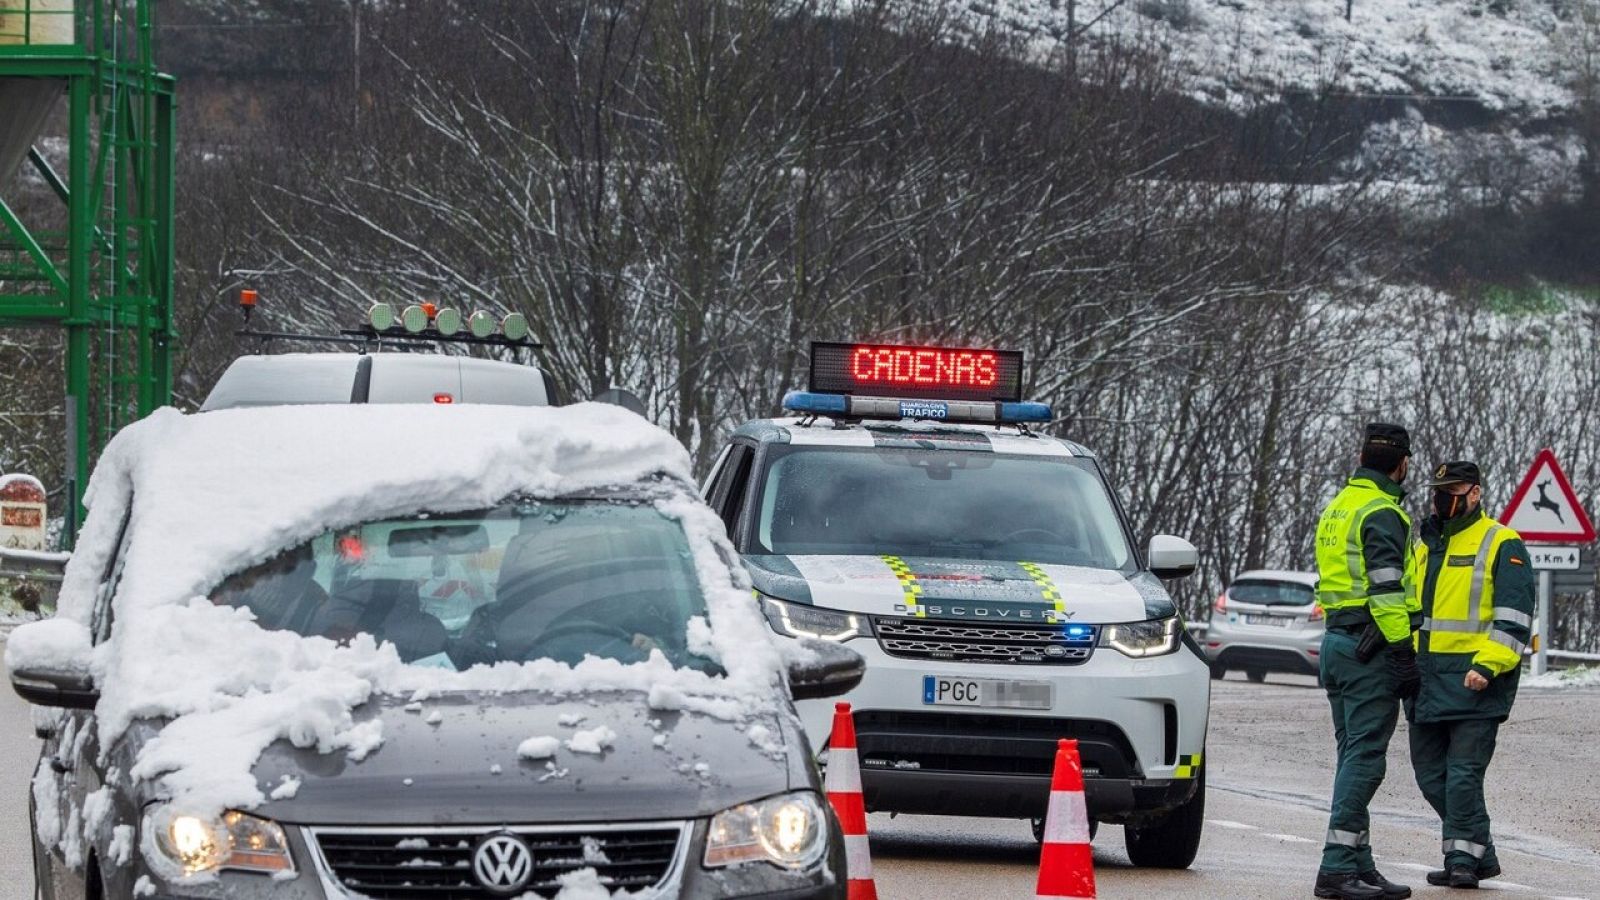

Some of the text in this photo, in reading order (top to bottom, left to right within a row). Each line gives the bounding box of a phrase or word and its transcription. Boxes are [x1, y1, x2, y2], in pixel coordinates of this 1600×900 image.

[853, 348, 996, 385] CADENAS
[901, 408, 946, 418] TRAFICO
[1544, 553, 1563, 564] Km
[893, 603, 1076, 620] DISCOVERY
[937, 679, 978, 702] PGC
